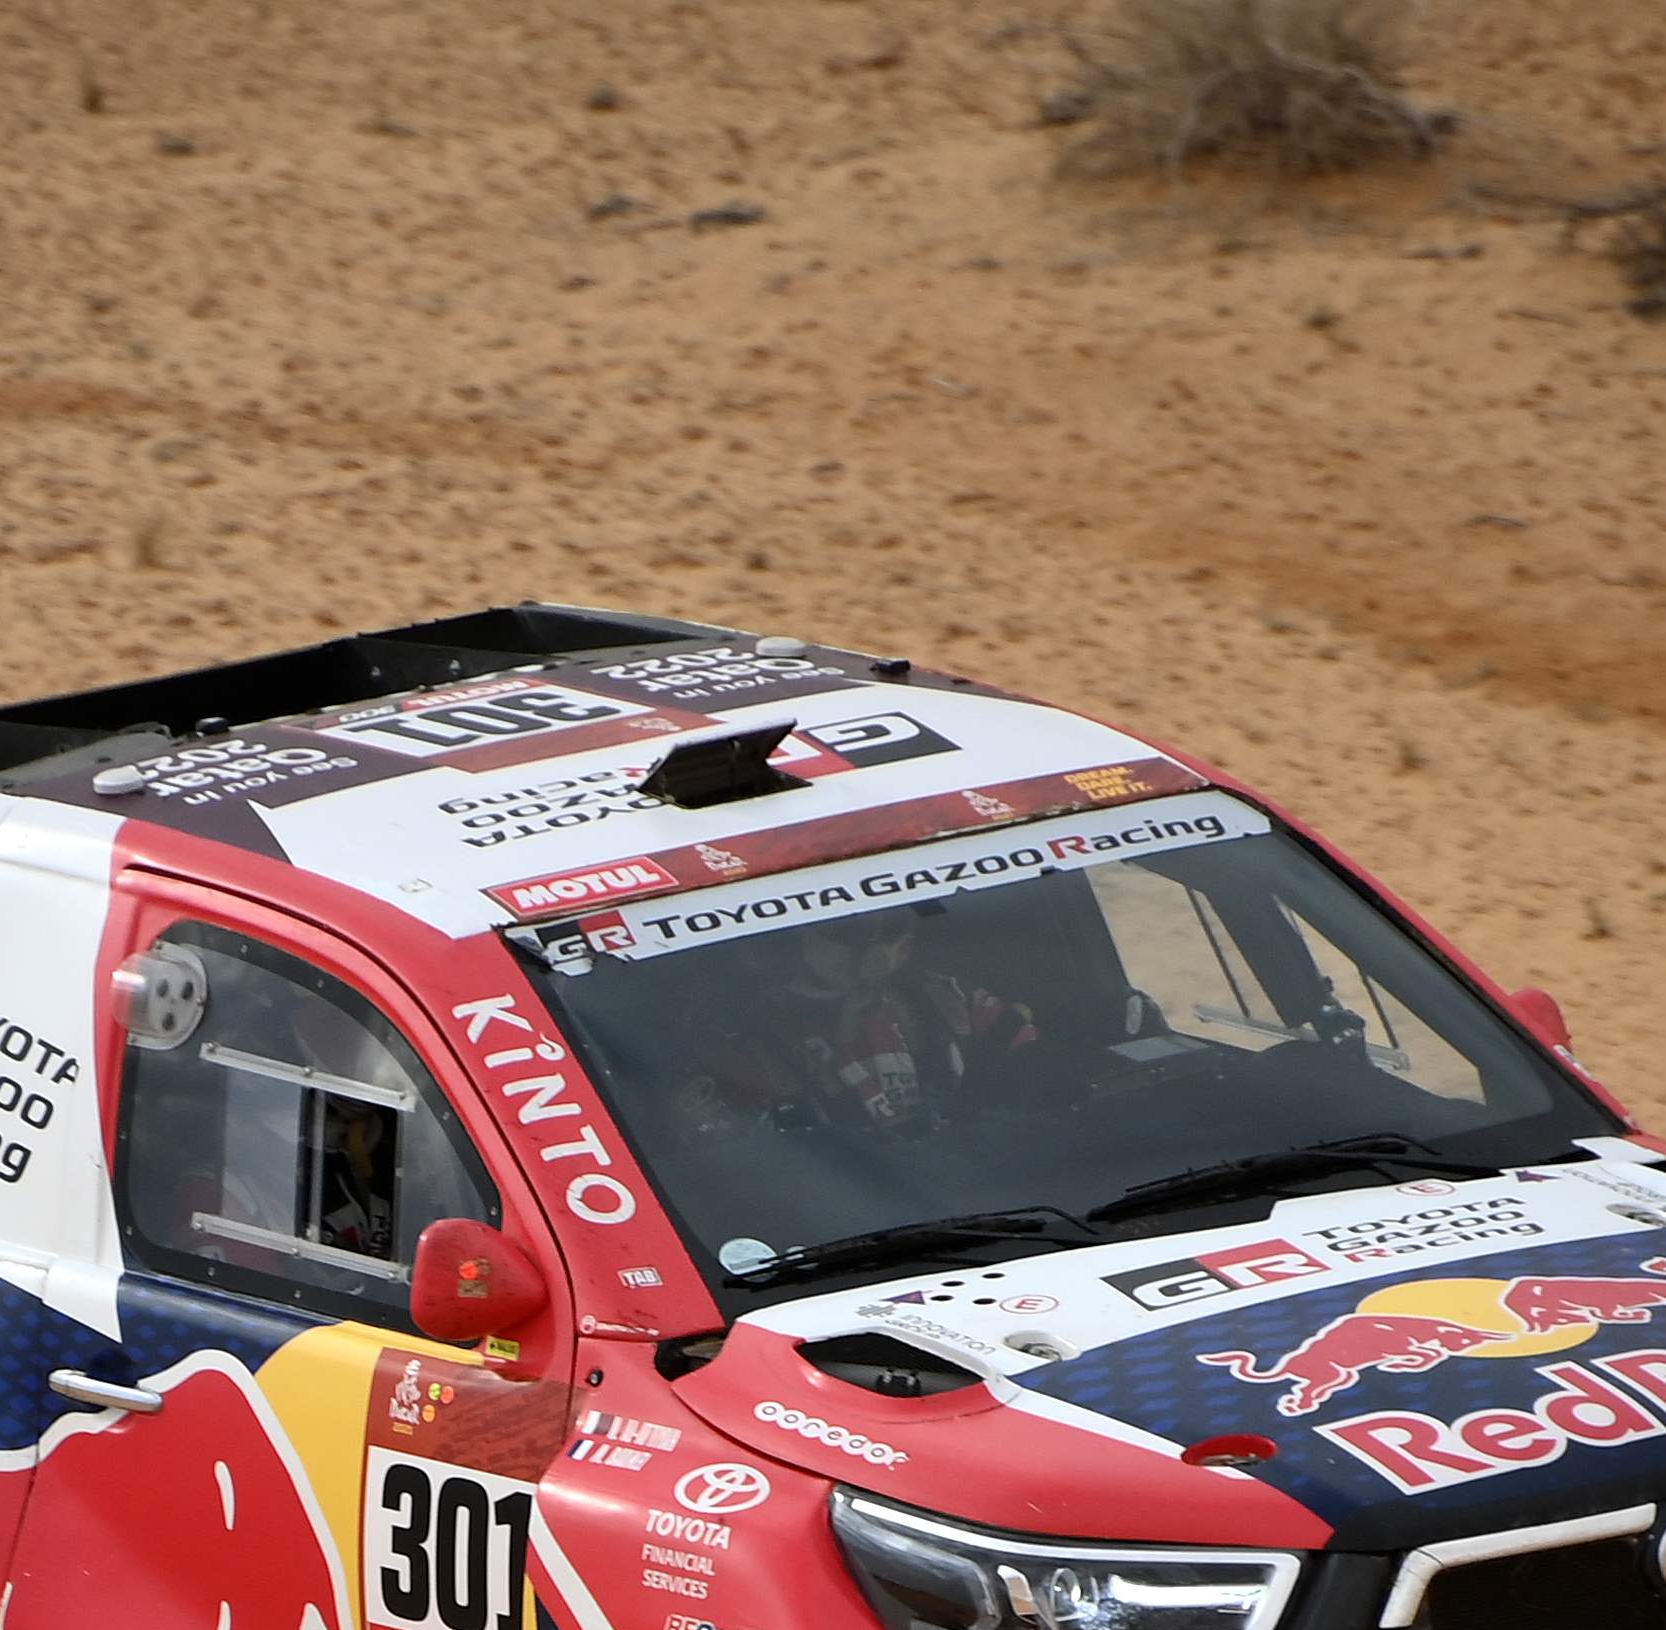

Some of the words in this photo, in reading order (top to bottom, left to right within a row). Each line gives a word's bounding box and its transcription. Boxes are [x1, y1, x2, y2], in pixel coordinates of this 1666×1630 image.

[346, 692, 621, 746] 301
[461, 796, 669, 848] OYOTA
[462, 783, 638, 828] AZOO
[512, 864, 662, 909] MOTUL
[542, 925, 636, 966] GR
[642, 886, 853, 940] TOYOTA
[859, 848, 1046, 899] GAZOO
[1047, 814, 1225, 859] Racing
[1301, 1197, 1526, 1240] TOYOTA
[1327, 1210, 1525, 1251] GAZOO
[1344, 1222, 1545, 1264] Racing
[1132, 1252, 1325, 1308] GR
[1333, 1365, 1655, 1489] Red
[645, 1509, 732, 1549] TOYOTA
[642, 1543, 716, 1577] FINANCIAL
[642, 1569, 709, 1600] SERVICES
